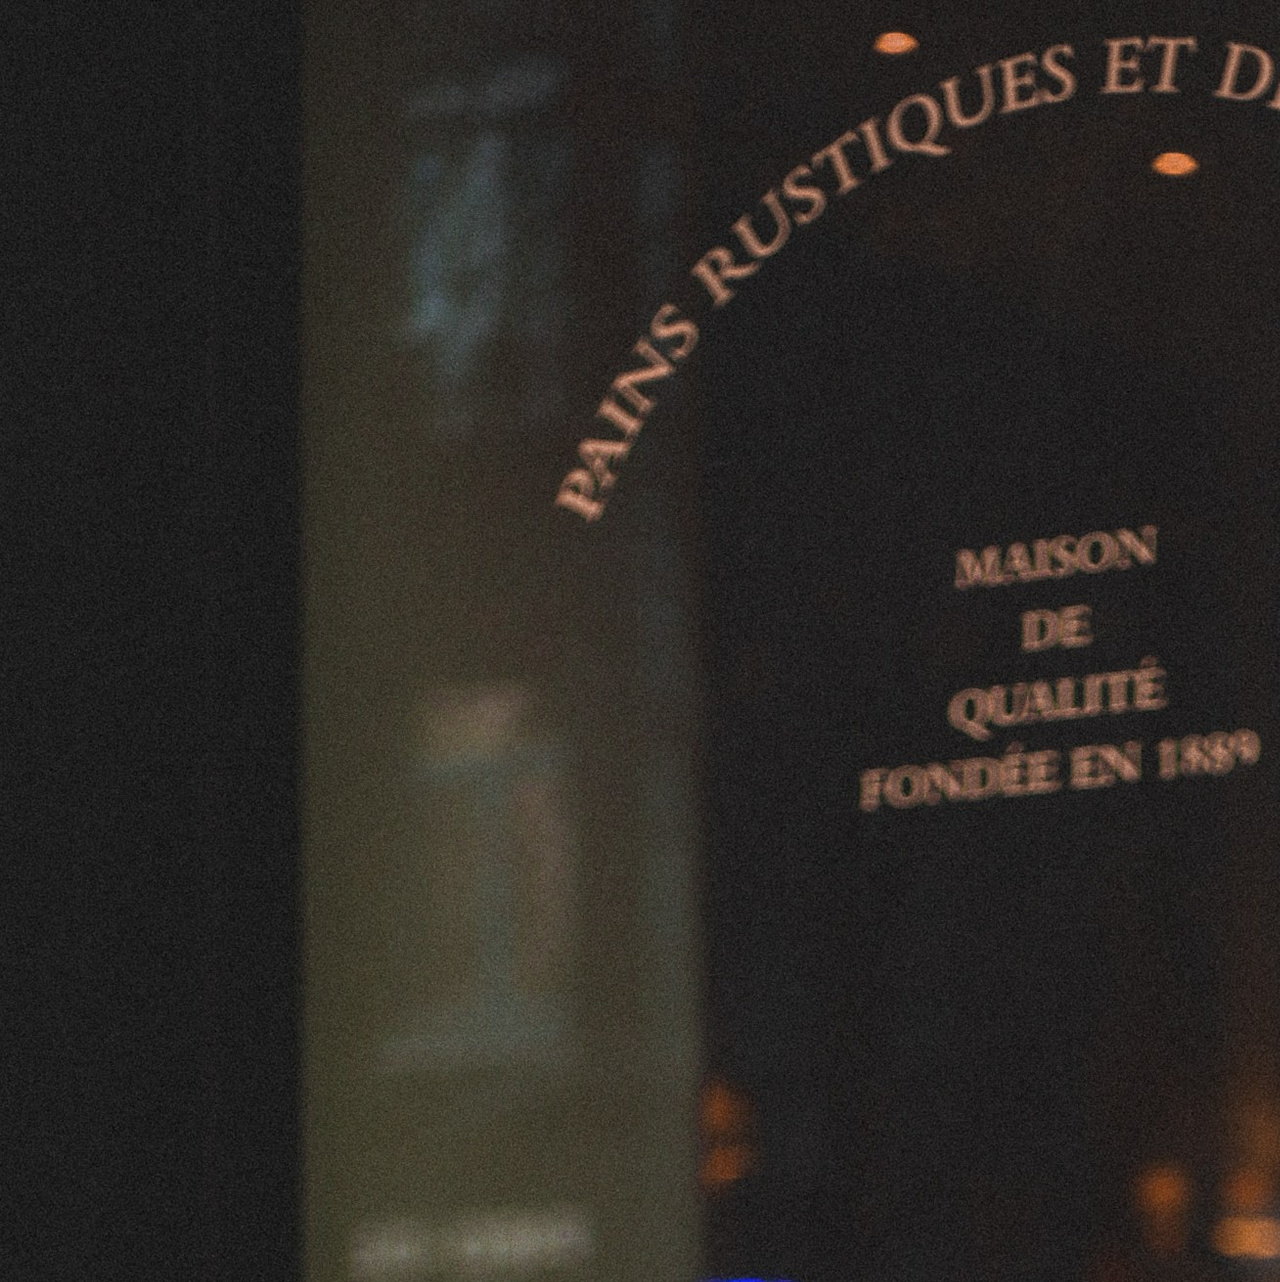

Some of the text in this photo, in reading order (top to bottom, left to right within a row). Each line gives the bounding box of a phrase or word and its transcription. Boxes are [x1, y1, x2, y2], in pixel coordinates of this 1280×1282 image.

[555, 303, 699, 522] PAINS
[692, 43, 1078, 307] RUSTIQUES
[1101, 36, 1197, 93] ET
[954, 524, 1159, 591] MAISON
[1021, 604, 1093, 652] DE
[947, 656, 1168, 741] QUALITÉ
[859, 728, 1262, 812] FONDÉE EN 1889
